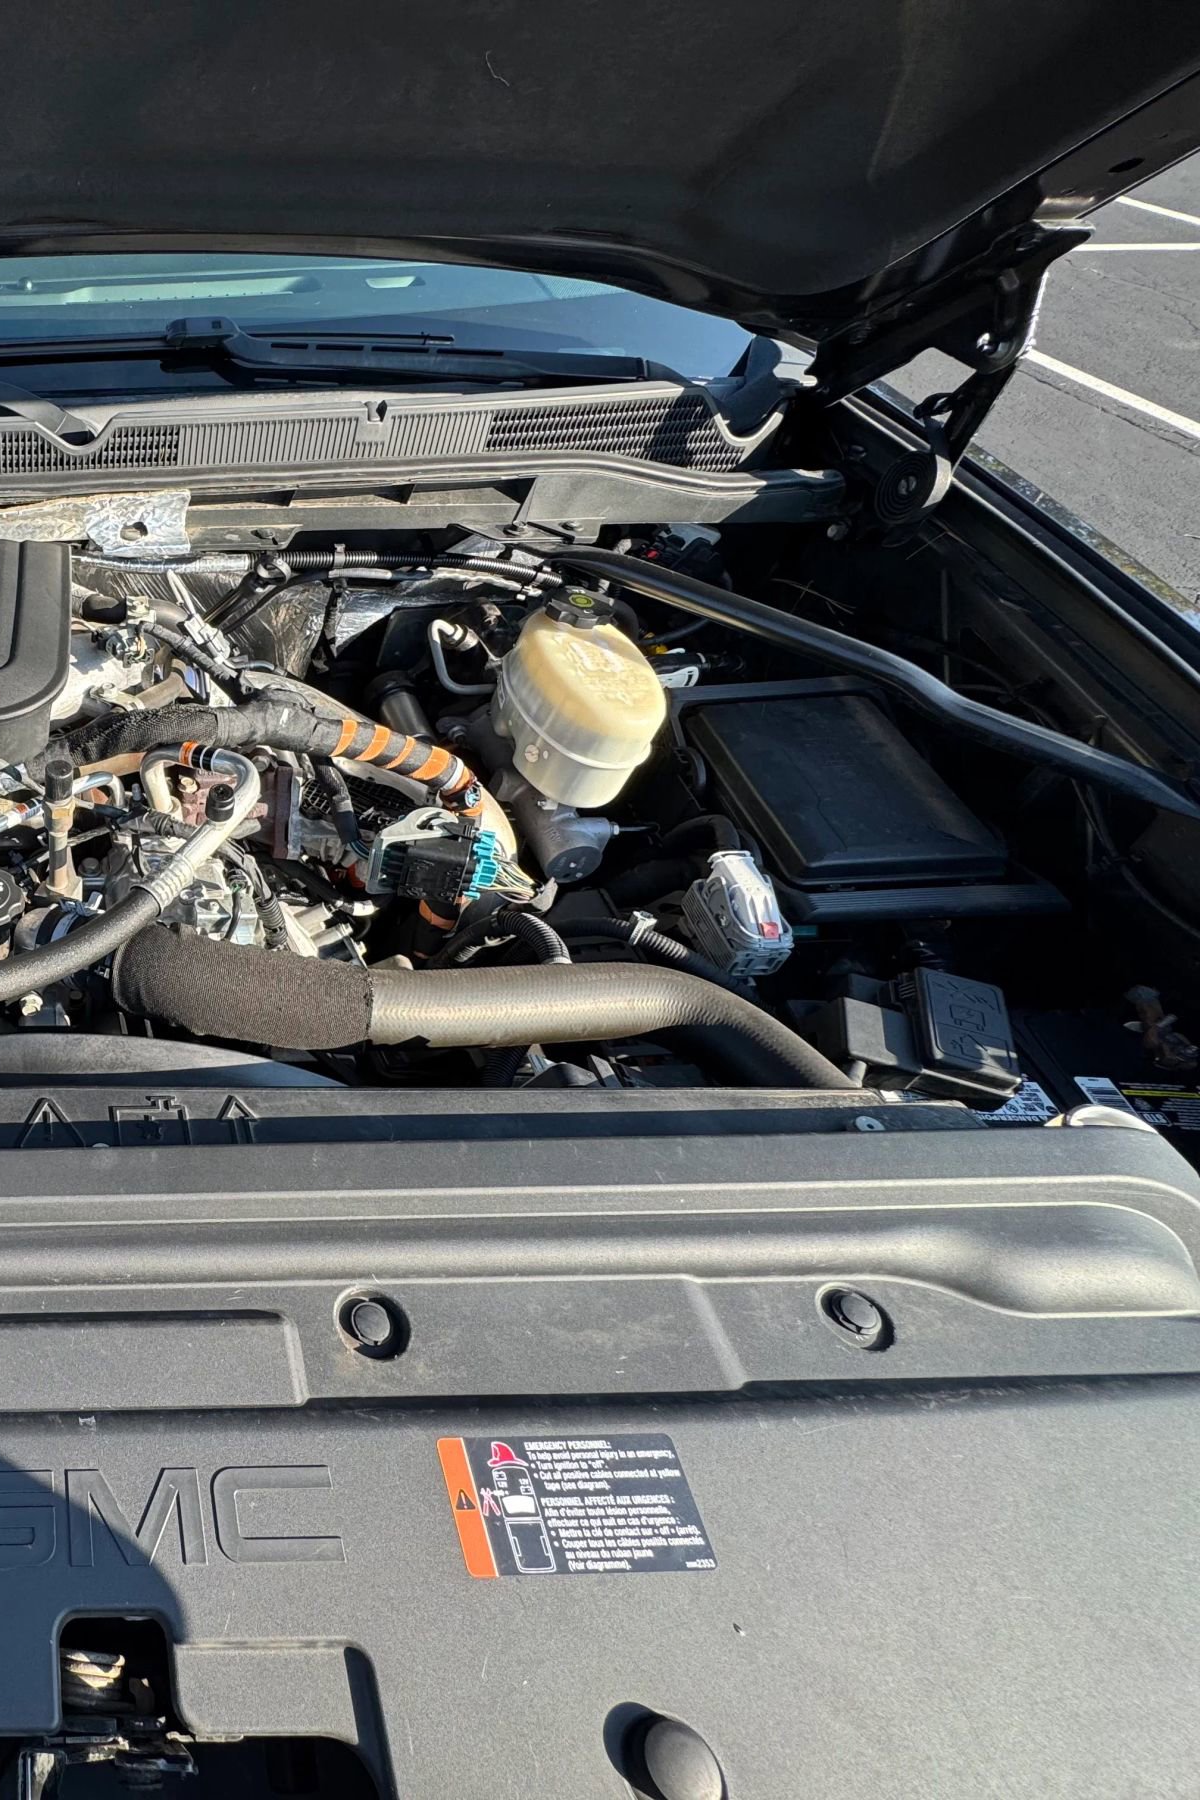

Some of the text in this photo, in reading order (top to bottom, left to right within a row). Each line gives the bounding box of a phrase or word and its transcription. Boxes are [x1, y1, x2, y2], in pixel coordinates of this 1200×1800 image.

[524, 1440, 612, 1450] EMERGENCY PERSONNEL:
[527, 1452, 536, 1460] To
[537, 1452, 552, 1461] help
[552, 1451, 570, 1460] avoid
[571, 1451, 599, 1460] personal
[600, 1450, 619, 1460] injury
[537, 1461, 581, 1470] Turn ignition
[540, 1468, 681, 1480] Cut all positive cables connected yellow
[544, 1482, 561, 1491] tape
[562, 1481, 577, 1491] (see
[540, 1496, 584, 1506] PERSONNEL
[584, 1494, 615, 1506] AFFECTÉ
[616, 1496, 632, 1504] AUX
[544, 1507, 559, 1517] Afin
[587, 1507, 605, 1516] toute
[606, 1506, 628, 1516] lésion
[547, 1518, 578, 1528] effectuer
[580, 1518, 589, 1526] ce
[590, 1518, 602, 1528] qui
[602, 1517, 616, 1526] suit
[617, 1518, 626, 1526] en
[627, 1518, 640, 1526] cas
[558, 1528, 582, 1538] Mettre
[592, 1527, 604, 1537] clé
[604, 1528, 614, 1536] de
[614, 1527, 642, 1536] contact
[642, 1528, 654, 1536] sur
[659, 1526, 671, 1536] off
[562, 1536, 705, 1550] Couper tous les câbles positifs connectés
[565, 1548, 654, 1560] au niveau du ruban jaune
[568, 1560, 585, 1572] (Voir
